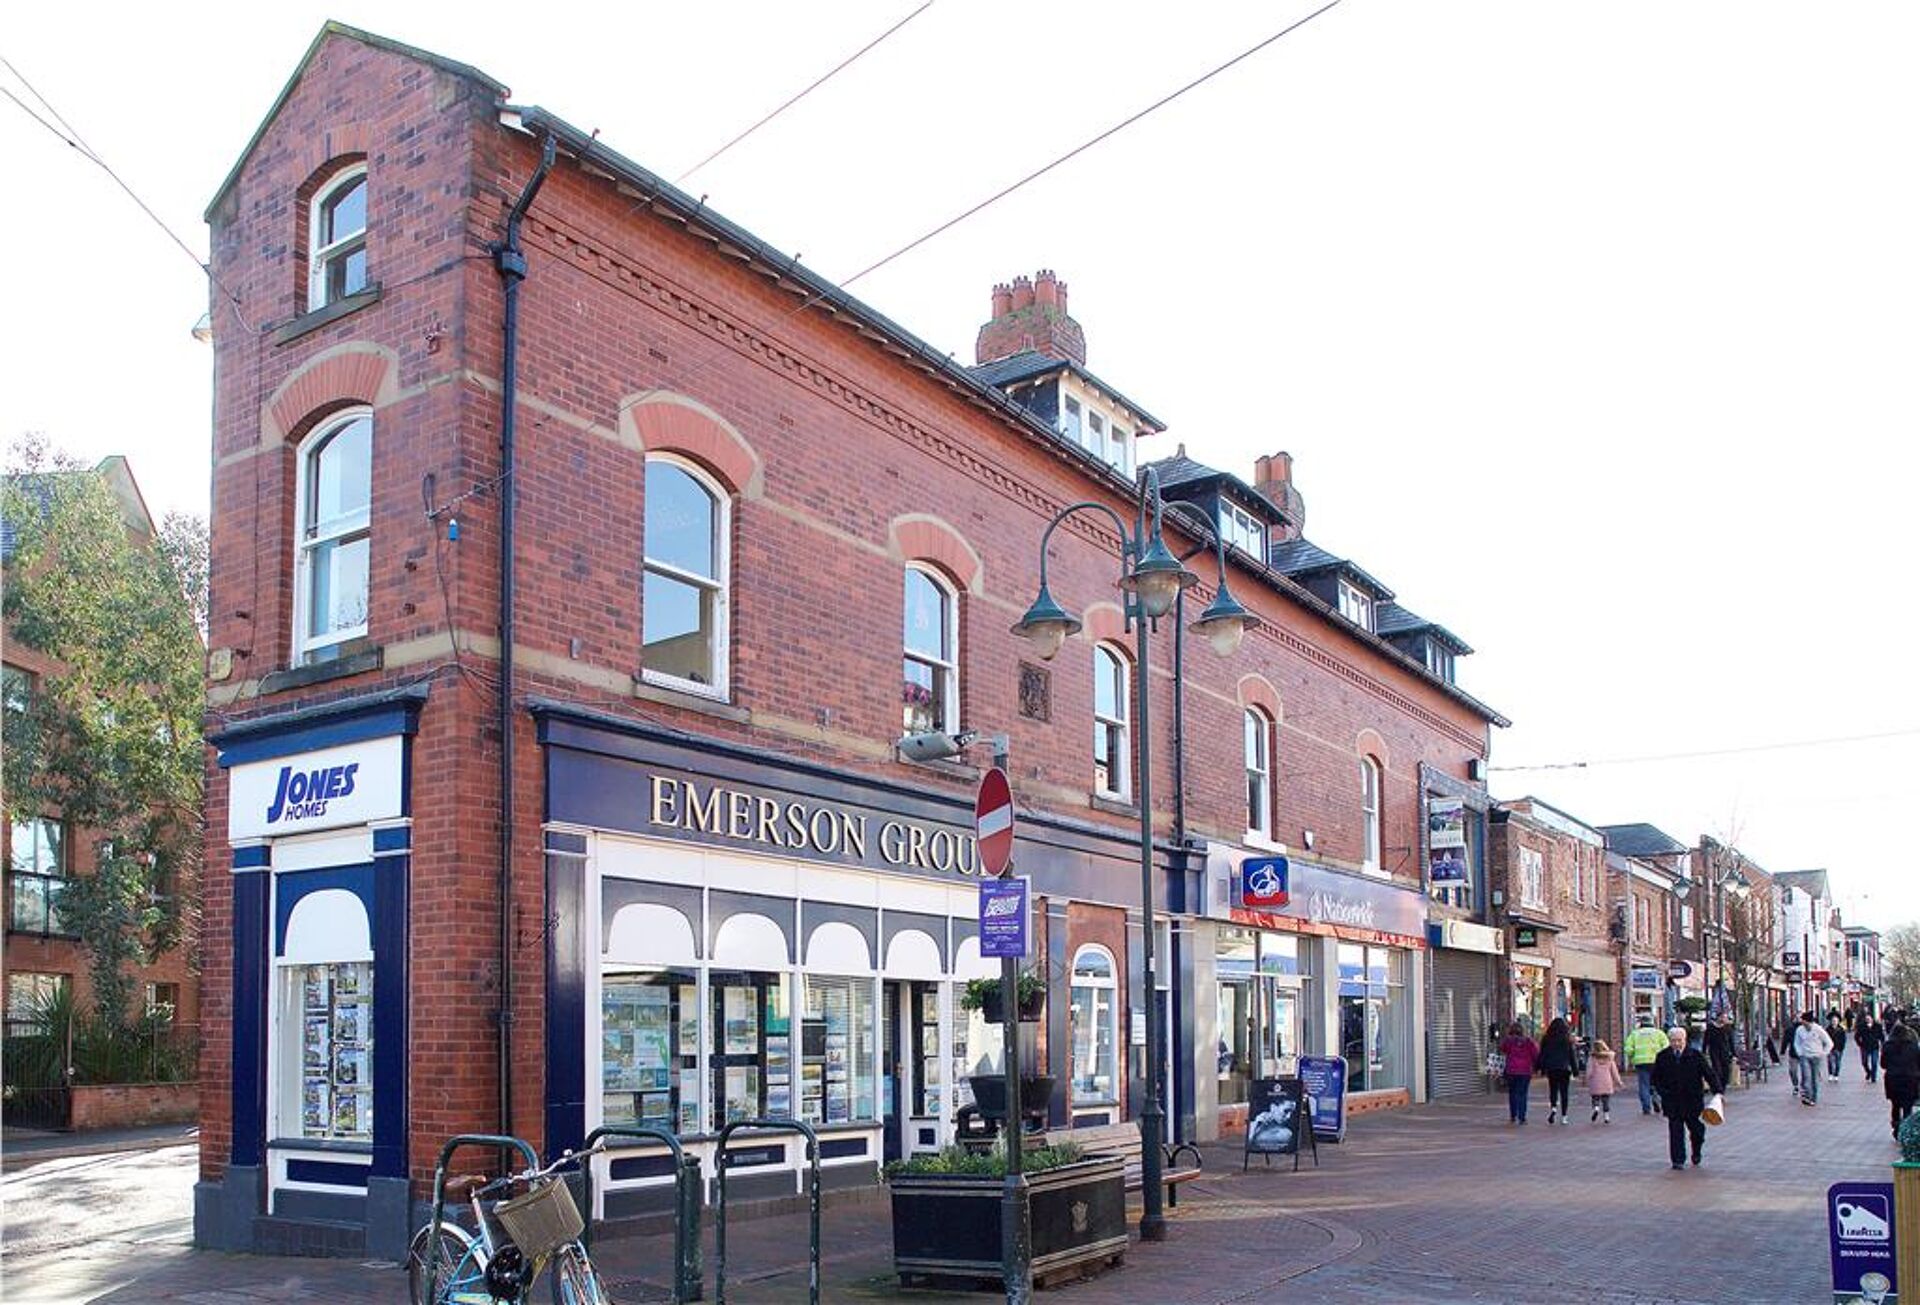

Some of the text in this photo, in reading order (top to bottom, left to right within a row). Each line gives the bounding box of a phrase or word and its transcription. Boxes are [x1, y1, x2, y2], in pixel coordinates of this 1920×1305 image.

[266, 763, 359, 823] JONES
[285, 800, 328, 821] HOMES
[647, 775, 988, 877] EMERSON GROU
